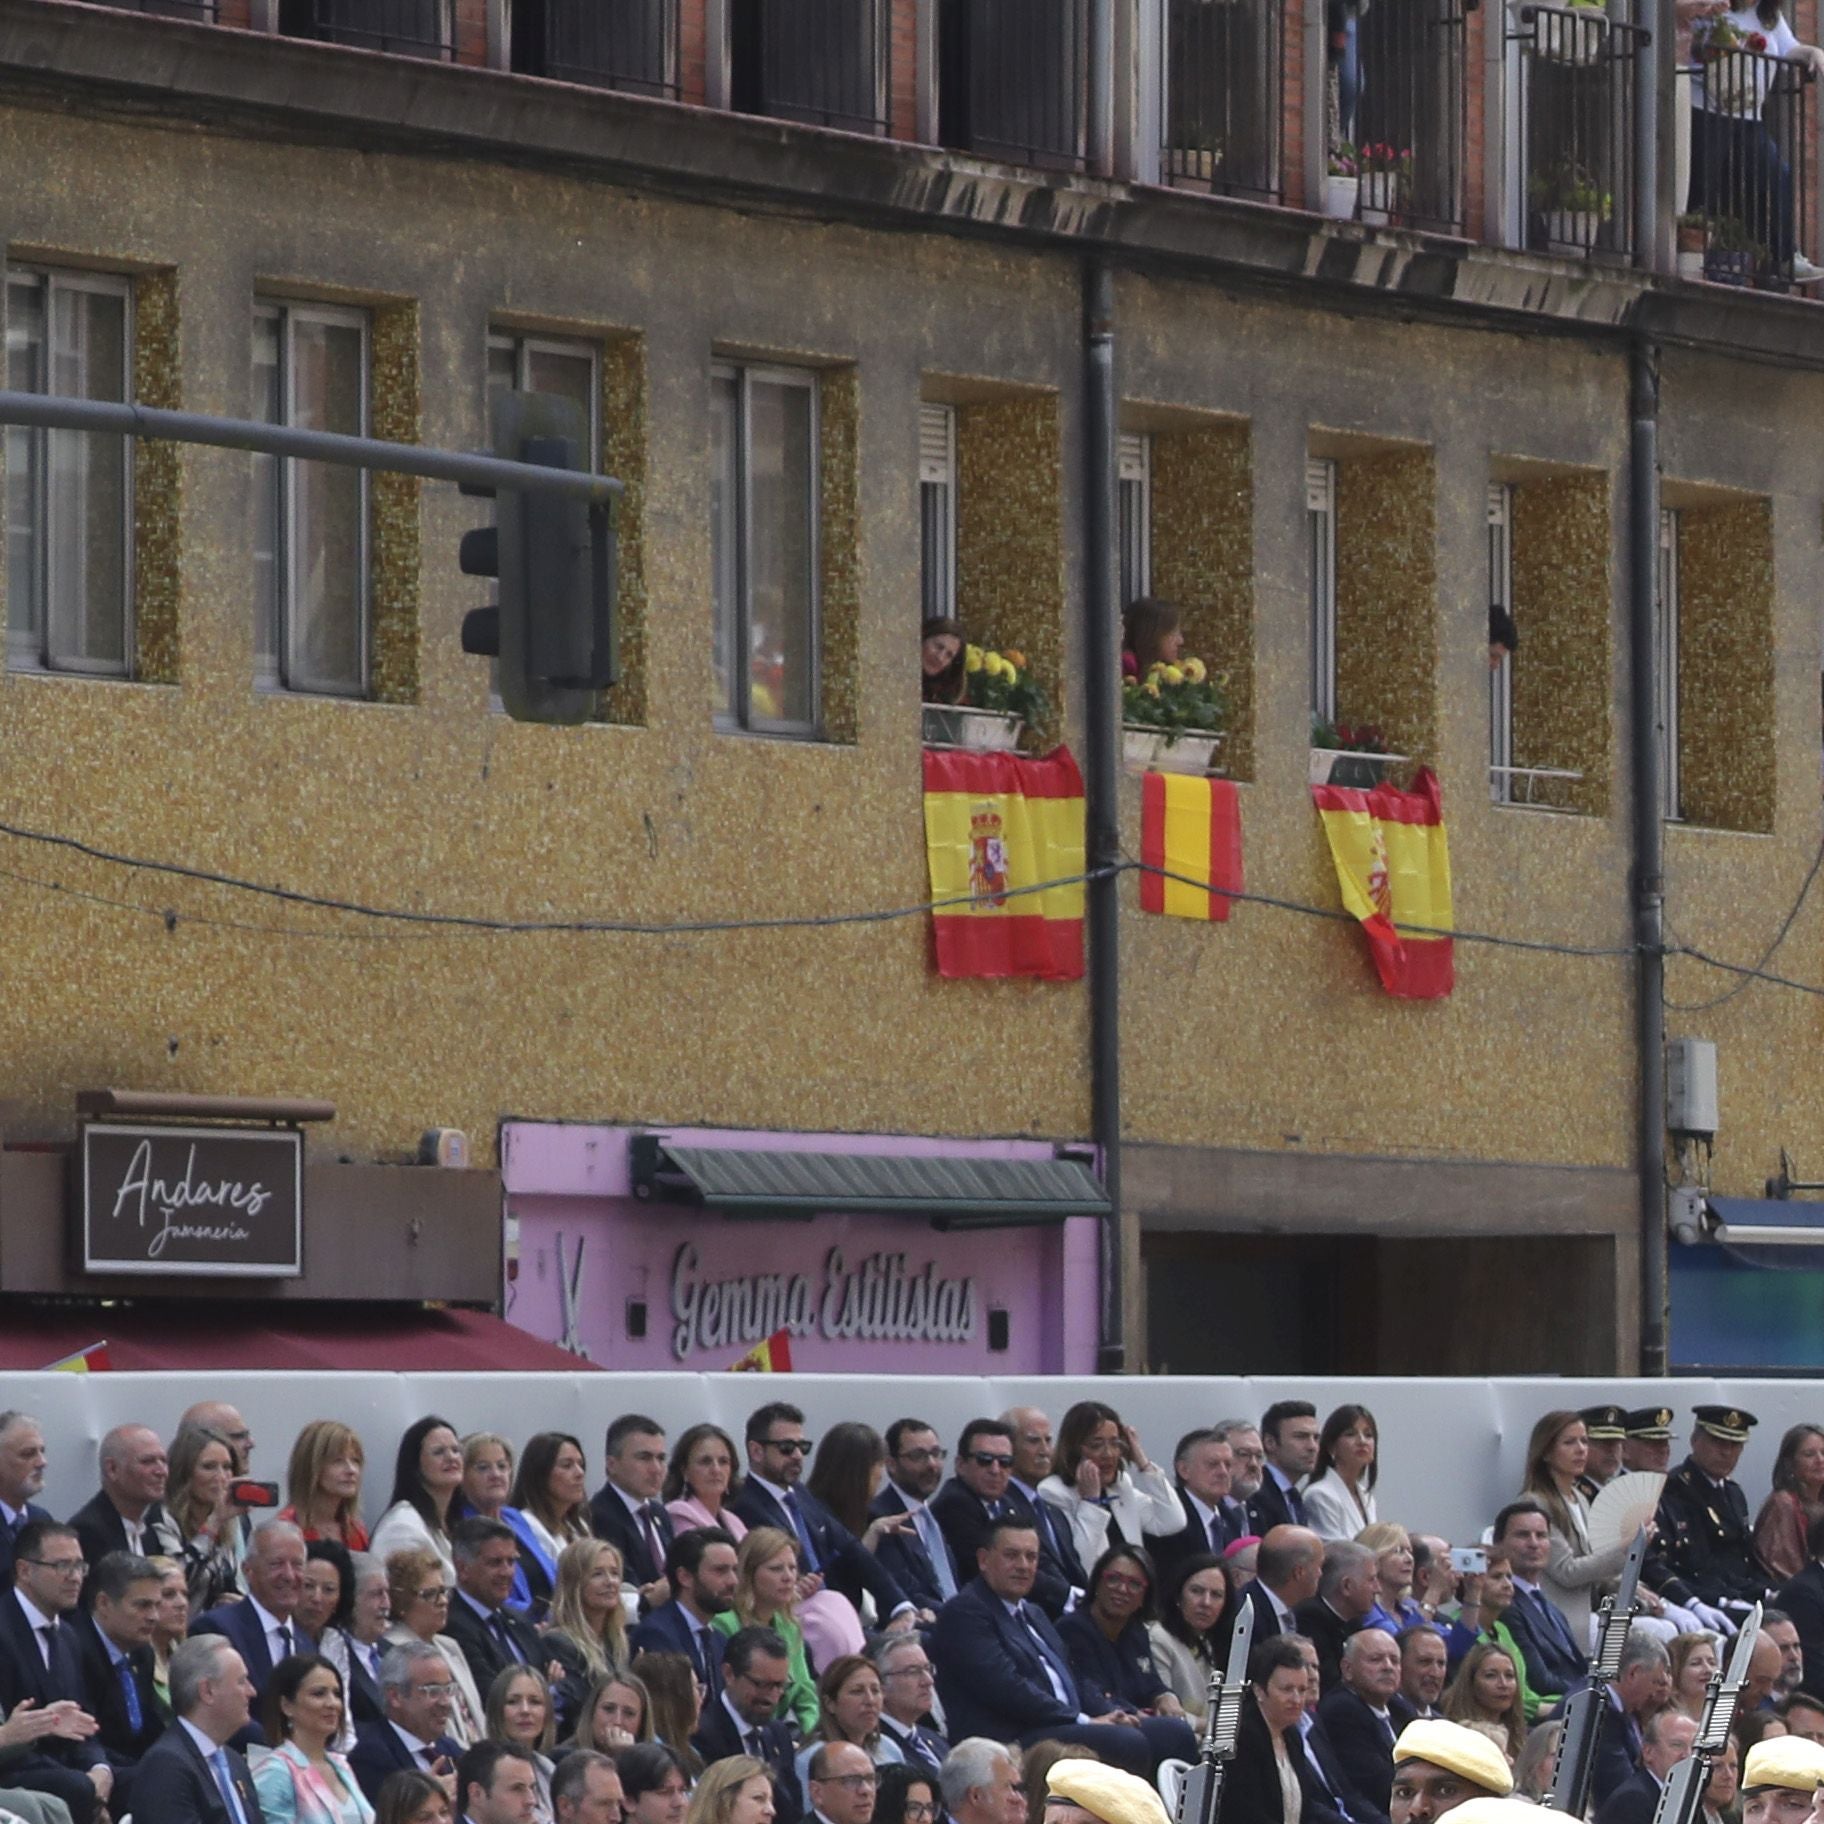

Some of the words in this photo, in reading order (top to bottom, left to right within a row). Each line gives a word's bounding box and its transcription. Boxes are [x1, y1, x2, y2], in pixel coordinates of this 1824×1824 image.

[113, 1139, 271, 1228] Andares
[671, 1242, 815, 1362] Gemma
[820, 1245, 977, 1342] Estilistas
